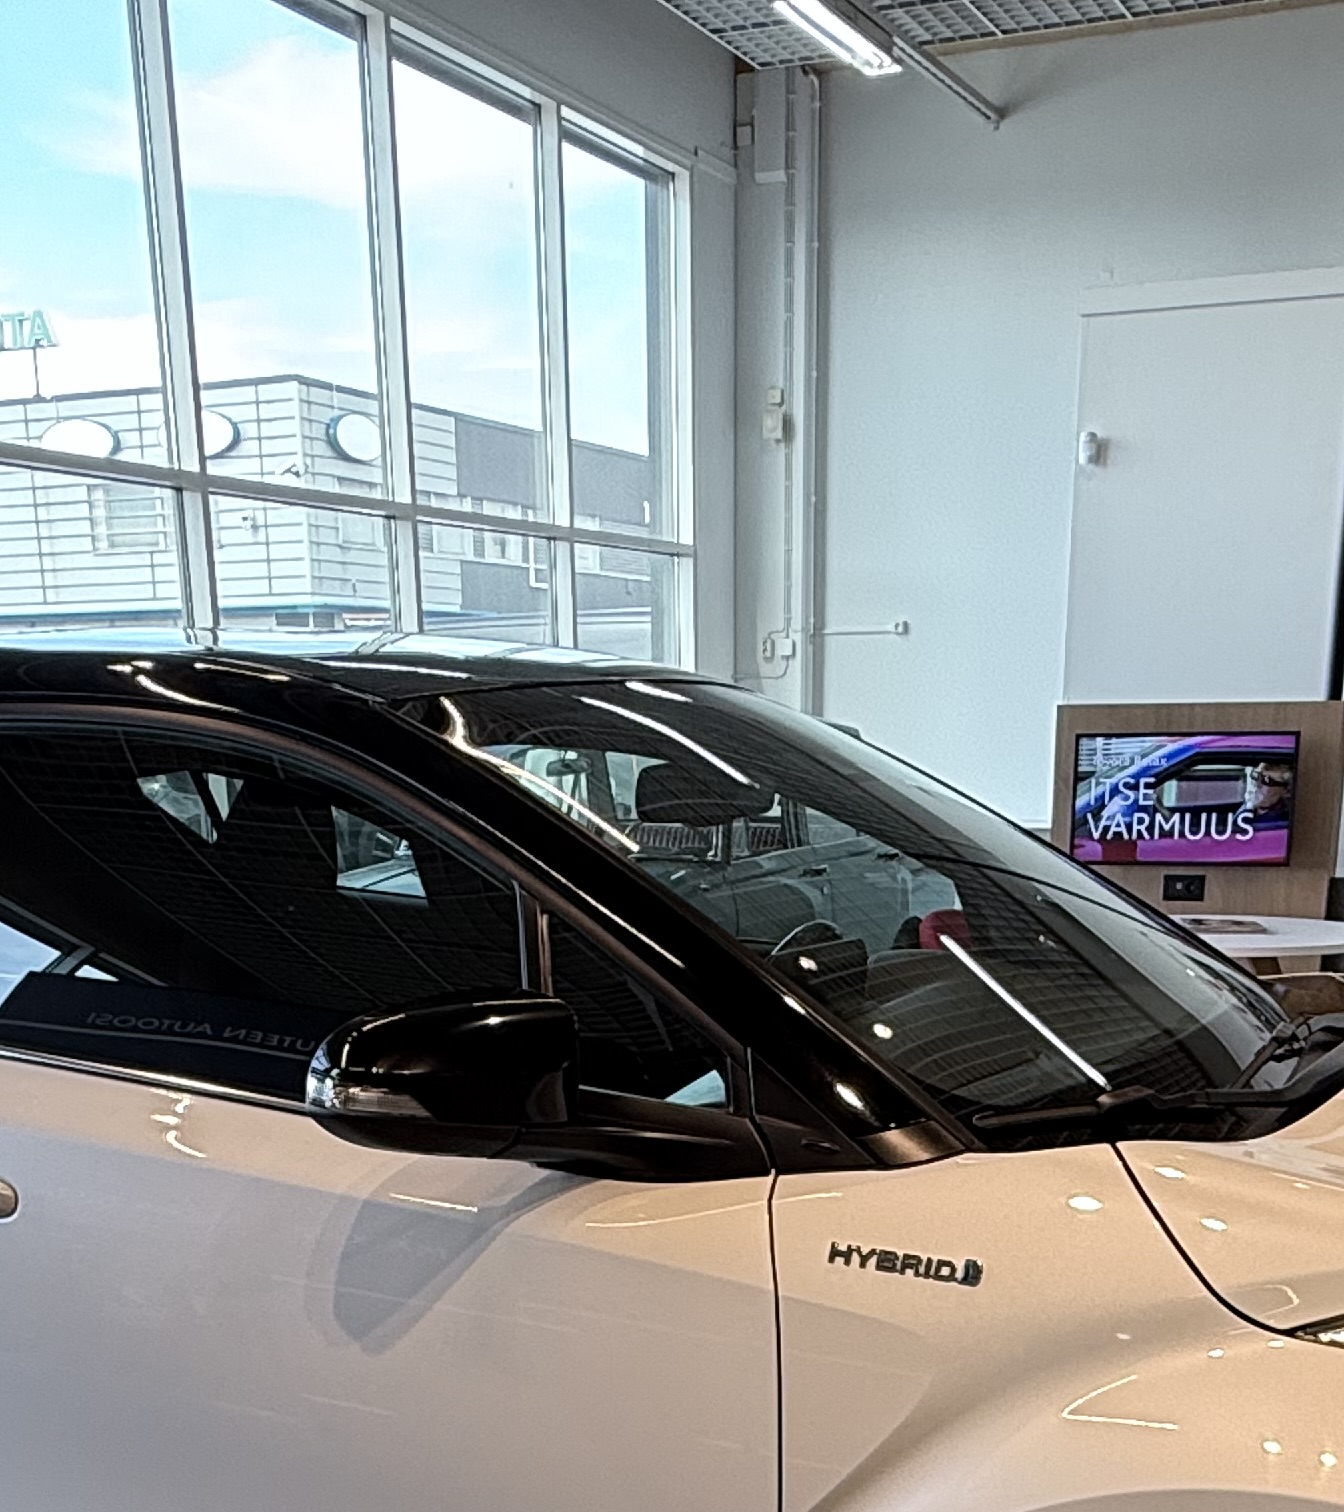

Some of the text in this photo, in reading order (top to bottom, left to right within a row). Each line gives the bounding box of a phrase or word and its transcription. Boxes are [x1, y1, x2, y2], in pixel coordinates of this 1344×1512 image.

[1090, 777, 1157, 806] ITSE
[1086, 811, 1255, 841] VARMUUS
[827, 1240, 959, 1283] HYBRID
